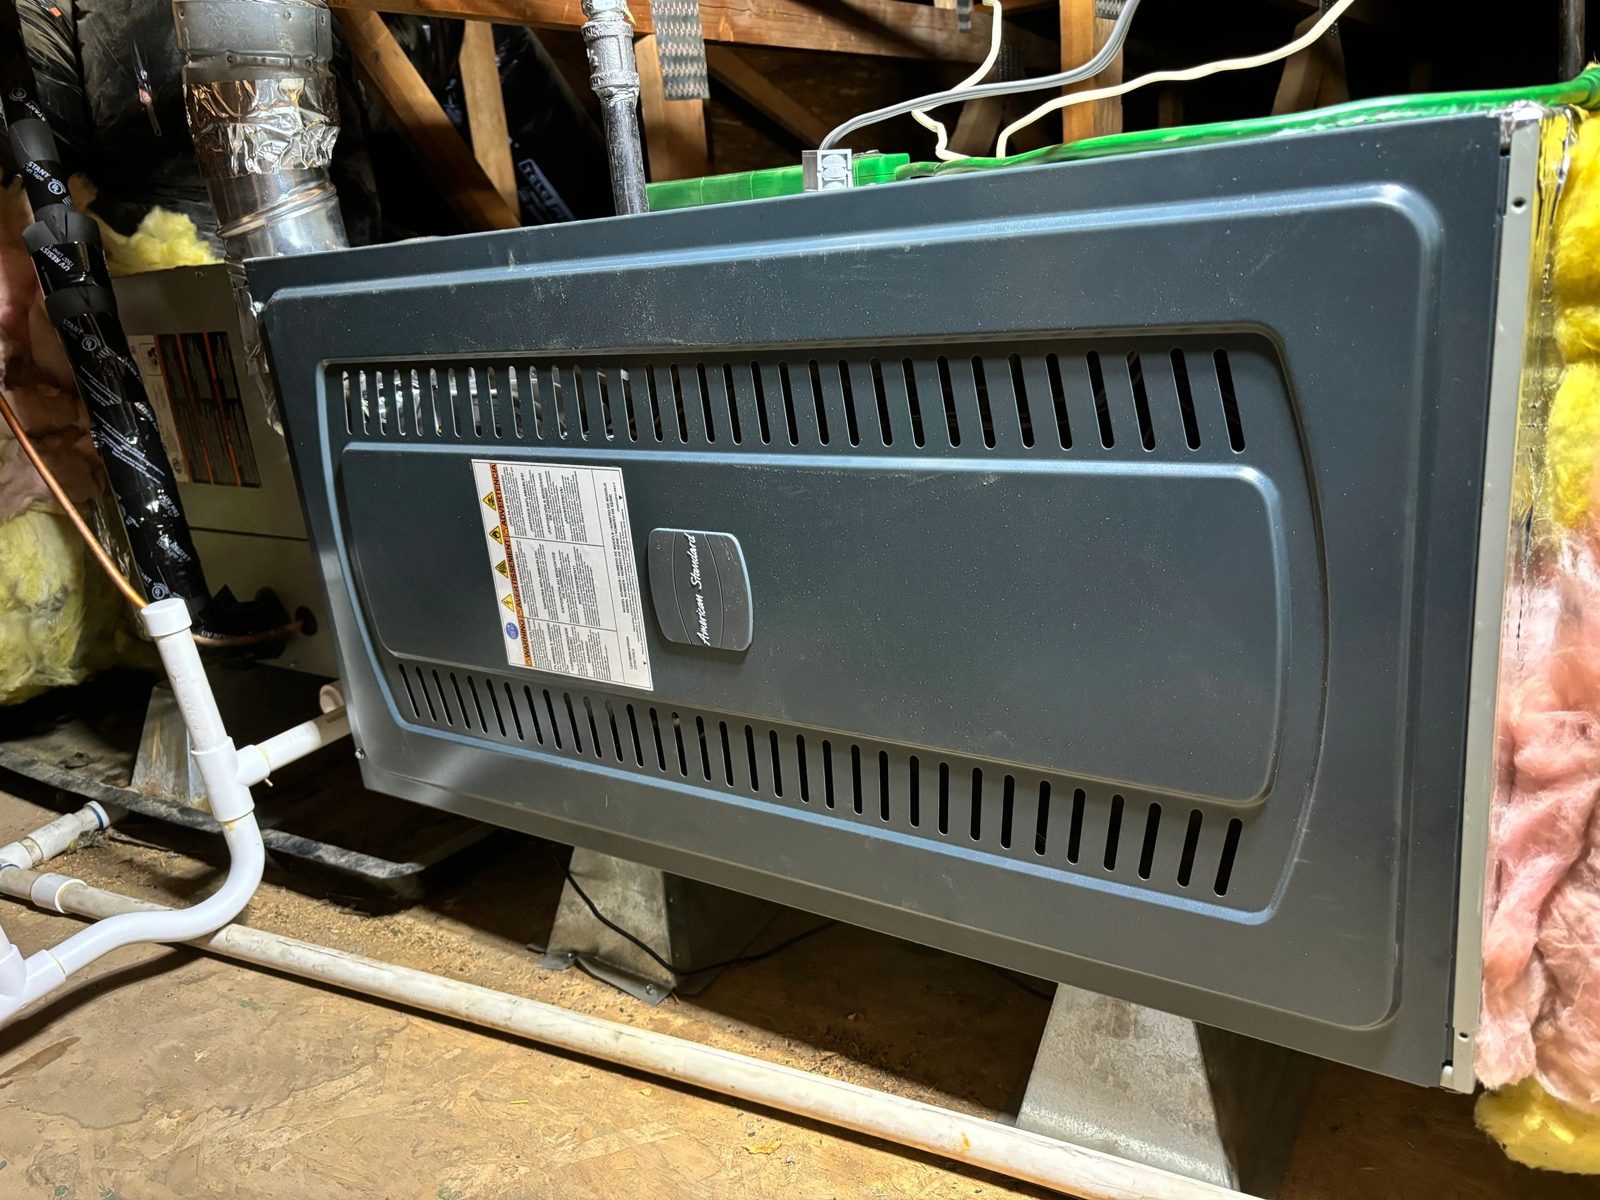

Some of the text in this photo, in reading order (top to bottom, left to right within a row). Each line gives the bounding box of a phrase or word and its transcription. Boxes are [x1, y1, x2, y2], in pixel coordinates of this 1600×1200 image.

[26, 158, 51, 181] STANT
[58, 260, 70, 272] UV
[490, 464, 507, 526] ADVERTENCIA
[504, 538, 521, 608] AVERTISSEMENT
[684, 532, 710, 646] American Standard
[518, 618, 530, 658] WARNING
